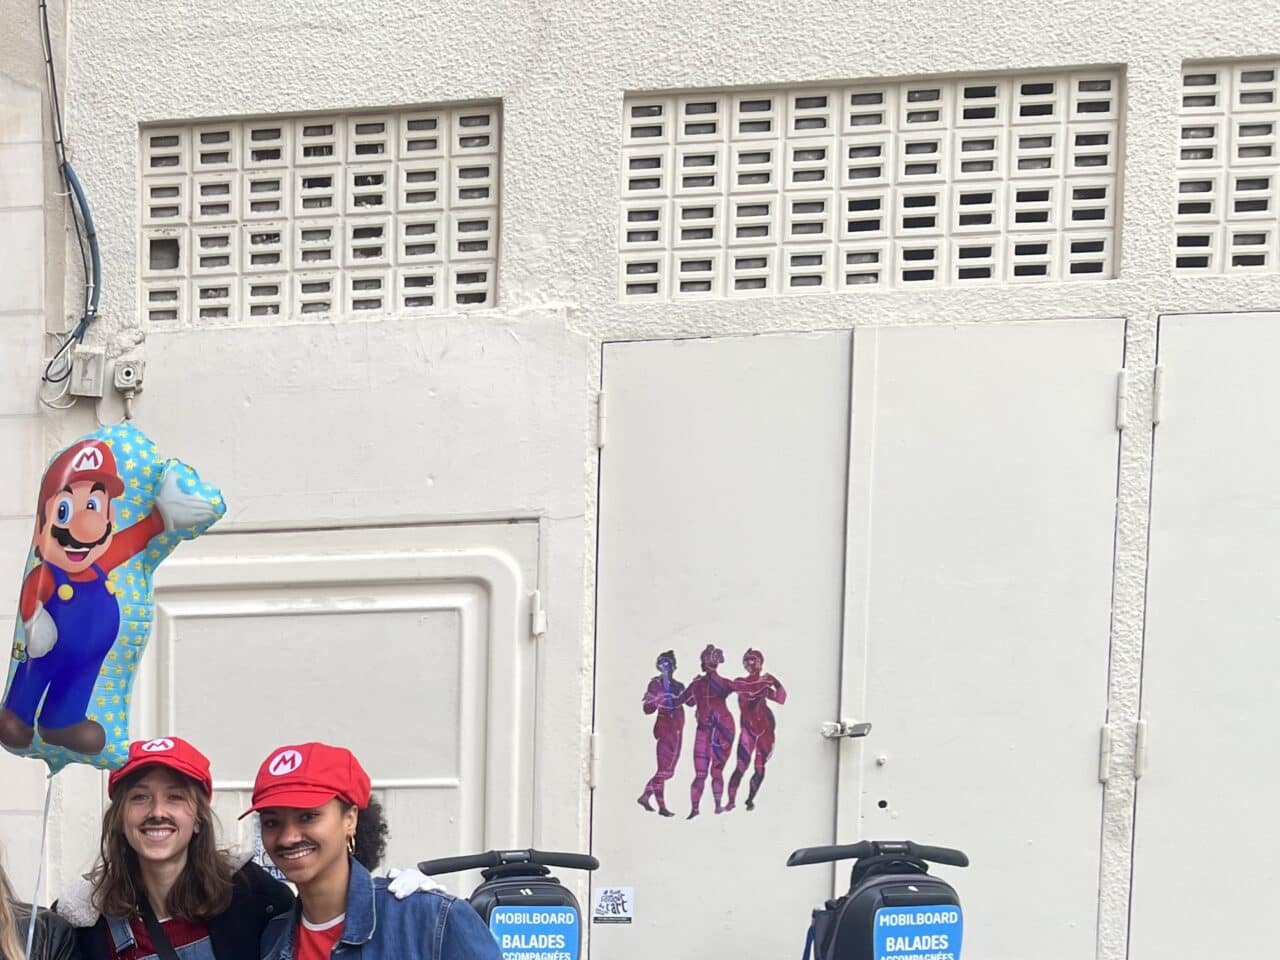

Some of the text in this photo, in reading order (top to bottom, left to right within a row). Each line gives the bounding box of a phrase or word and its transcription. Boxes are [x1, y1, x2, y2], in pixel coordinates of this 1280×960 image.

[495, 912, 575, 925] MOBILBOARD
[880, 911, 958, 927] MOBILBOARD
[502, 934, 565, 949] BALADES
[886, 934, 949, 953] BALADES
